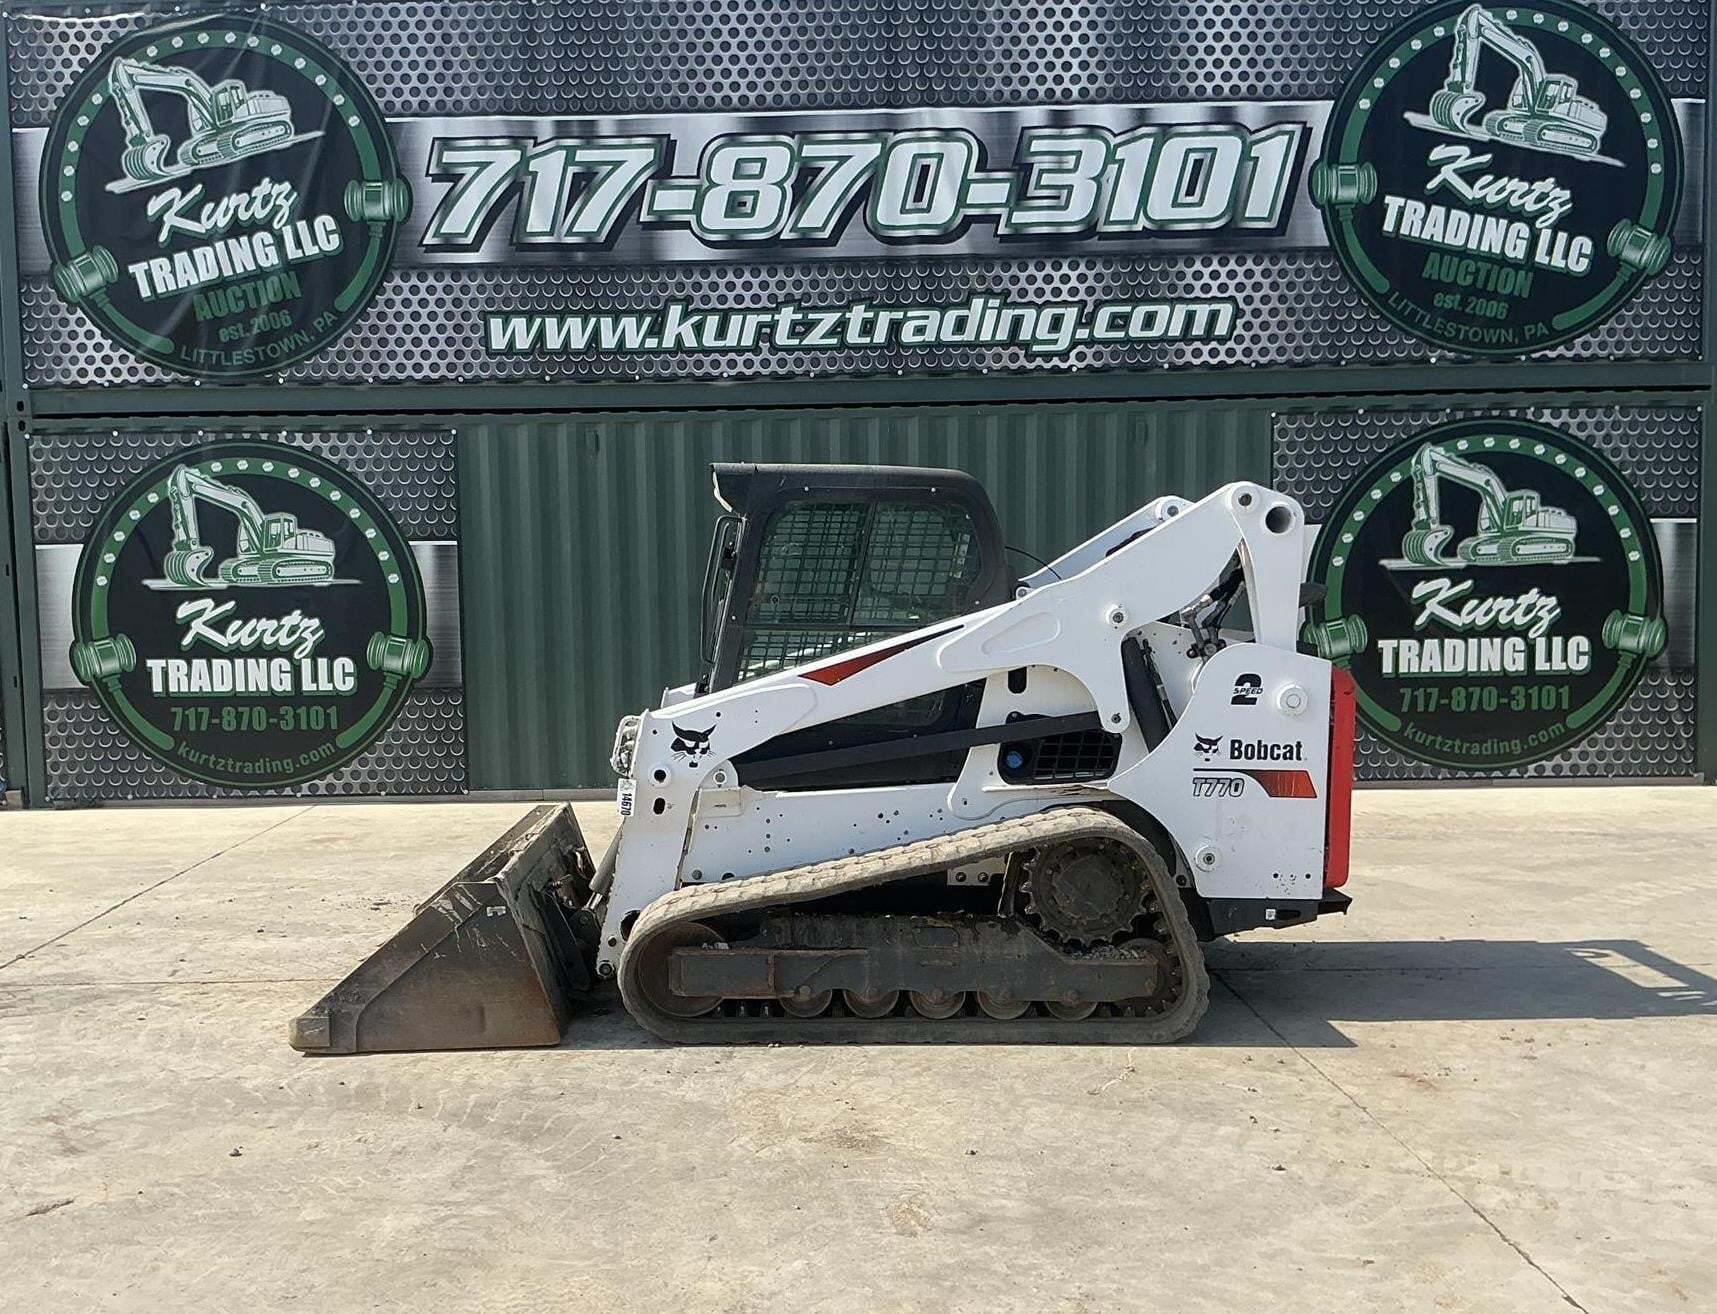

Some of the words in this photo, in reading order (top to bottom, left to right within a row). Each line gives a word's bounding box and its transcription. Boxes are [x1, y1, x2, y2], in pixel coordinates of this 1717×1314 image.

[425, 124, 1306, 247] 717-870-3101
[1425, 144, 1573, 228] Kurtz
[147, 178, 298, 244] Kurtz
[1383, 195, 1530, 263] TRADING
[1534, 228, 1595, 274] LLC
[128, 231, 279, 298] TRADING
[281, 214, 342, 260] LLC
[1422, 252, 1534, 298] AUCTION
[193, 271, 301, 322] AUCTION
[313, 310, 339, 333] PA
[486, 294, 1238, 355] www.kurtztrading.com
[1387, 291, 1520, 345] LITTLESTOWN,
[1523, 322, 1550, 341] PA
[176, 598, 325, 659] Kurtz
[1411, 577, 1562, 640] Kurtz
[146, 657, 293, 696] TRADING
[301, 656, 357, 695] LLC
[1378, 636, 1526, 676] TRADING
[1535, 635, 1592, 675] LLC
[1231, 673, 1262, 706] 2
[1233, 686, 1264, 696] SPEED
[1400, 685, 1571, 713] 717-870-3101
[170, 705, 338, 732] 717-870-3101
[1403, 722, 1566, 756] kurtztrading.com
[177, 740, 336, 775] kurtztrading.com
[1229, 739, 1304, 761] Bobcat
[620, 792, 632, 816] 14670
[1192, 777, 1246, 798] T770
